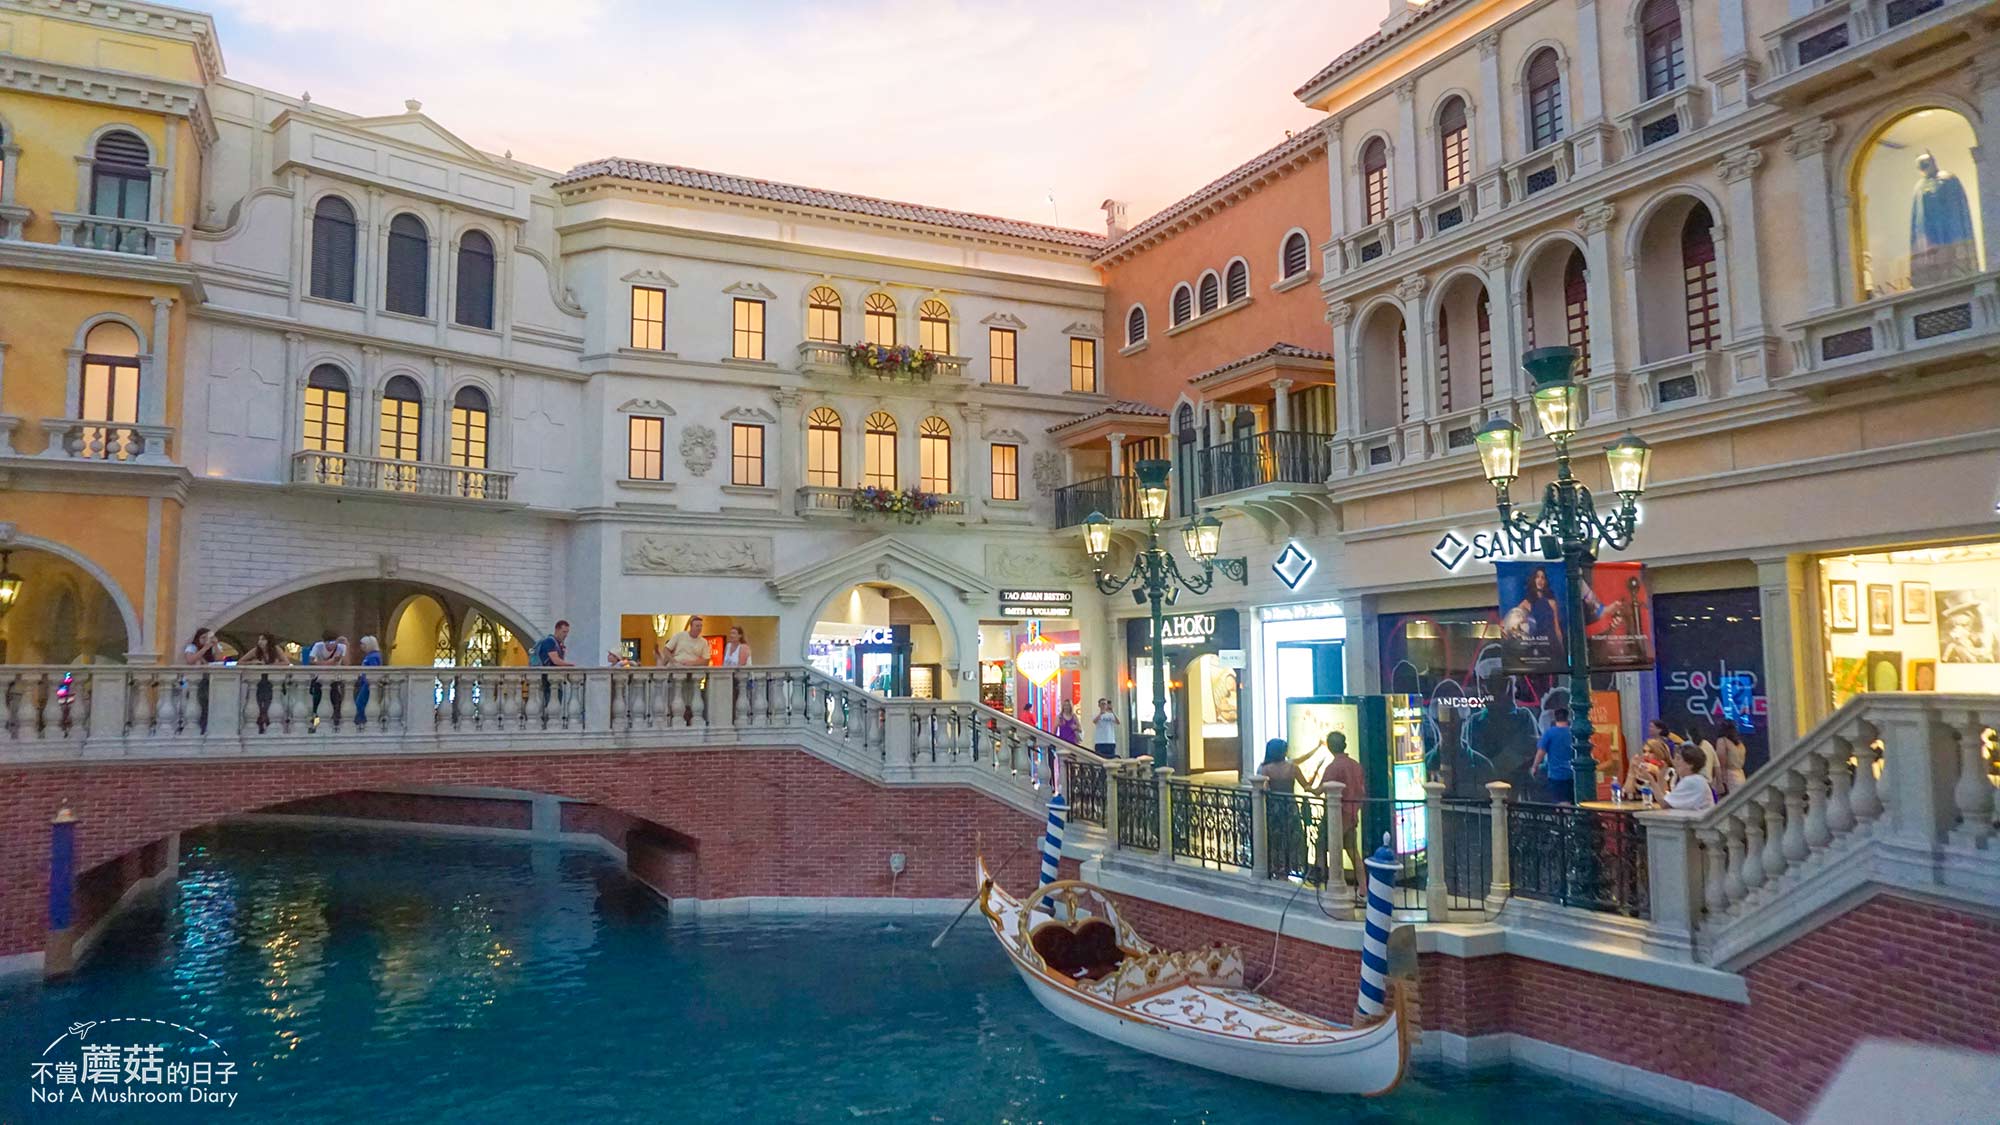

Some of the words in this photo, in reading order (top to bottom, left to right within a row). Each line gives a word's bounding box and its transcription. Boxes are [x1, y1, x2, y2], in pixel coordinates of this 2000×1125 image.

[1004, 592, 1019, 600] TAO
[1020, 592, 1042, 600] ASIAN
[1043, 592, 1071, 601] BISTRO
[1173, 614, 1216, 637] HOKU
[1664, 659, 1758, 691] SQUID
[1686, 695, 1768, 725] GAME
